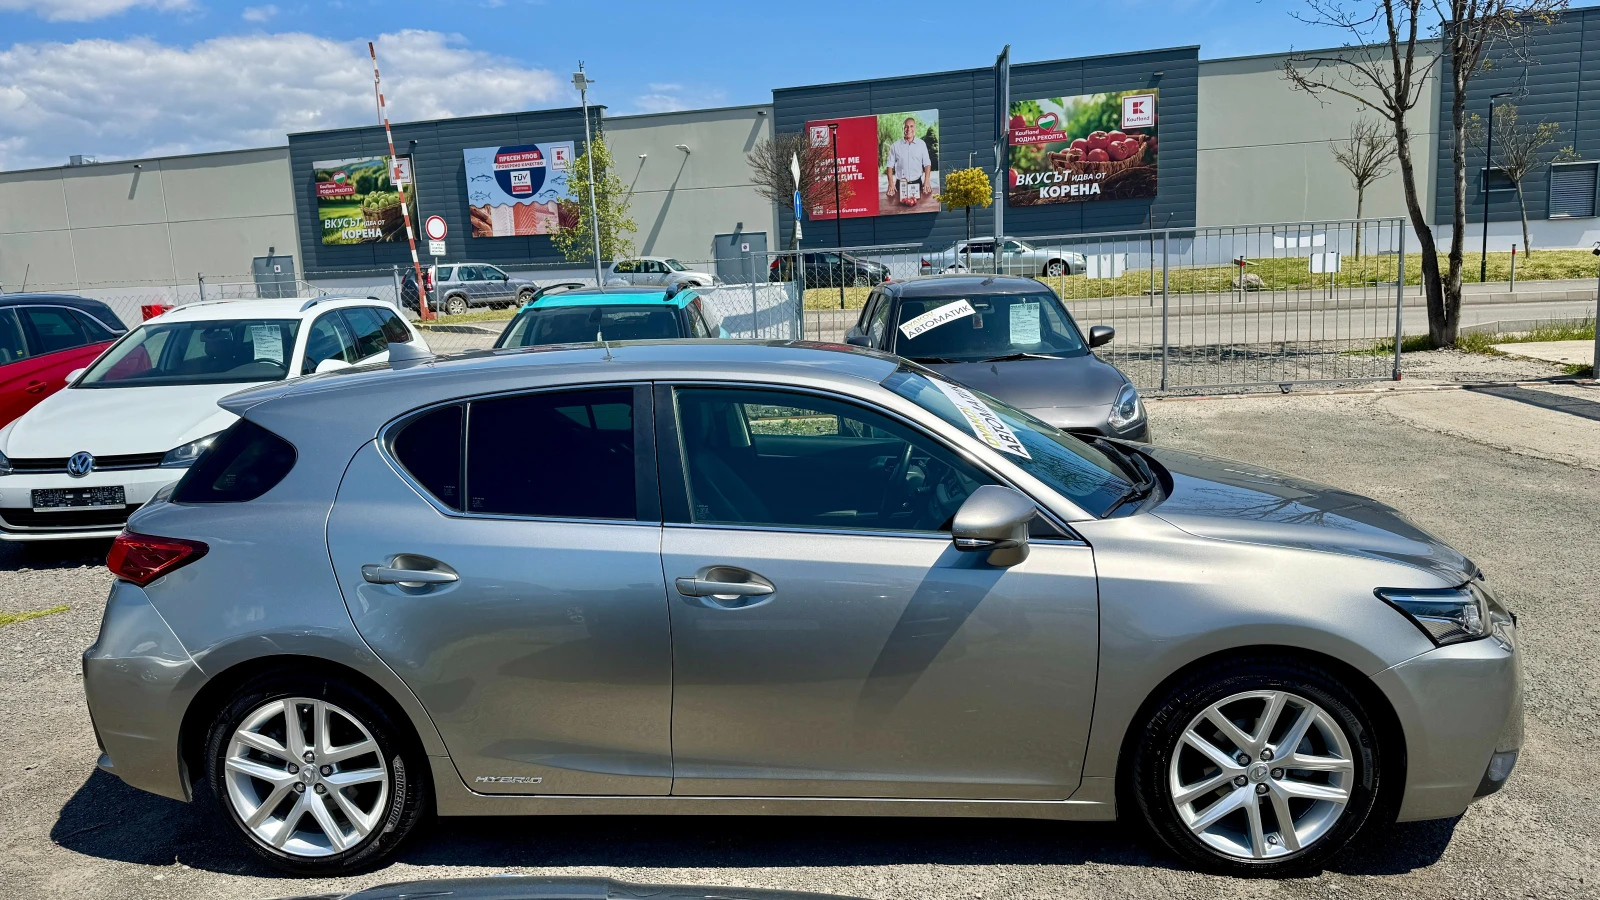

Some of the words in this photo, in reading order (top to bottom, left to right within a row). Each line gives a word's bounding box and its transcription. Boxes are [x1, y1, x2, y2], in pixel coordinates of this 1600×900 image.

[1037, 133, 1064, 141] РЕКОЛТА
[499, 154, 521, 162] ПРЕСЕН
[521, 152, 538, 160] УЛОВ
[848, 156, 860, 164] МЕ
[1015, 170, 1072, 186] ВКУСЪТ
[1072, 174, 1093, 182] ИДВА
[1039, 183, 1100, 198] КОРЕНА
[324, 217, 361, 229] ВКУСЪТ
[341, 228, 382, 239] КОРЕНА
[908, 304, 971, 338] АВТОМАТИК
[475, 776, 543, 784] HYBRID
